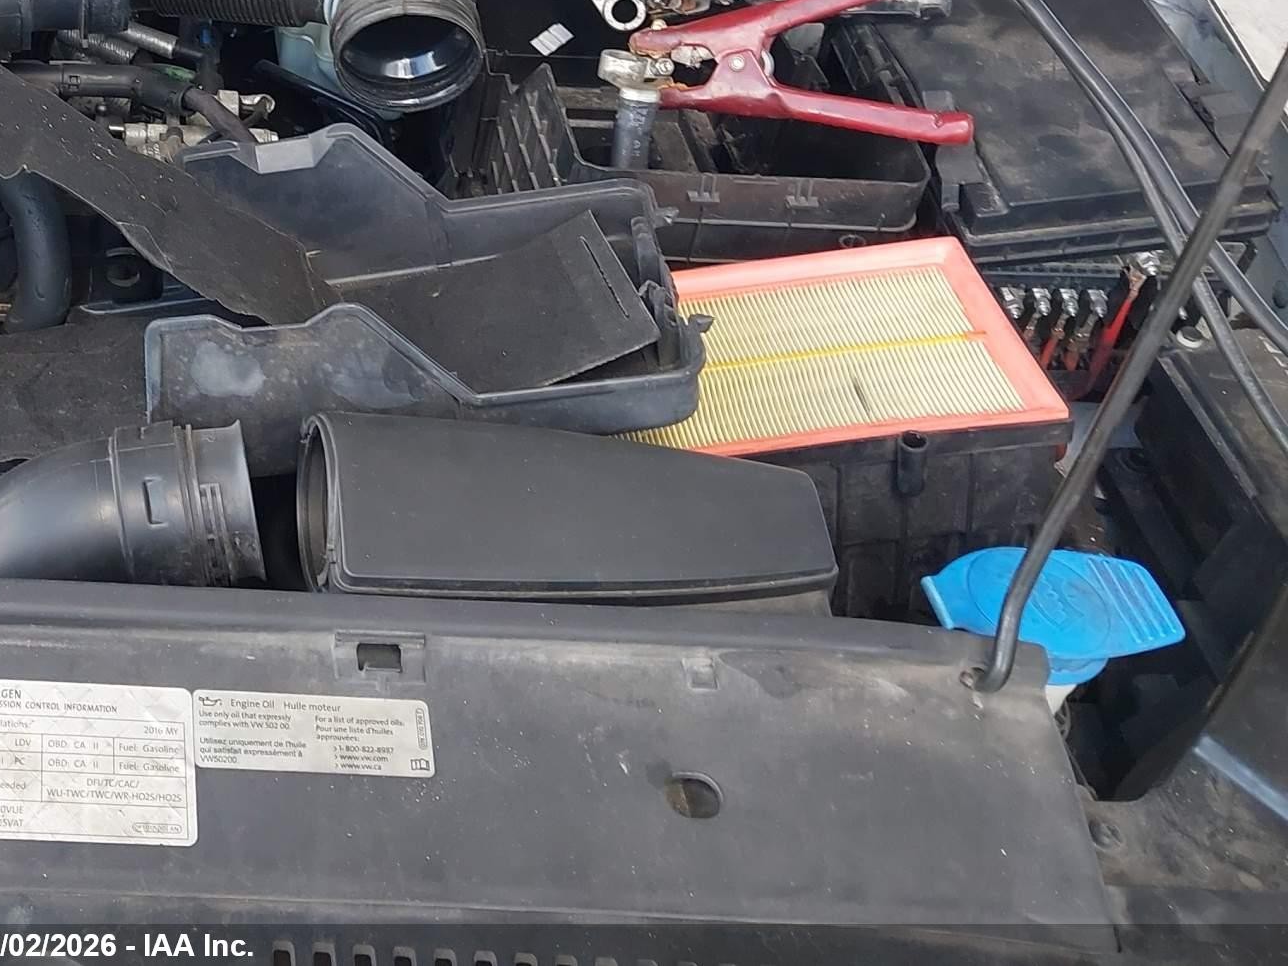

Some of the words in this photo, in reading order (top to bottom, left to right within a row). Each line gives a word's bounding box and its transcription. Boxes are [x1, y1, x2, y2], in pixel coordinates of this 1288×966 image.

[25, 701, 60, 710] CONTROL
[64, 702, 118, 713] INFORMATION
[231, 699, 261, 709] Engine
[262, 700, 275, 709] Oil
[309, 703, 341, 712] moteur
[198, 710, 212, 718] Use
[214, 712, 229, 721] only
[258, 714, 292, 723] expressly
[333, 716, 345, 724] list
[355, 719, 389, 727] approved
[198, 720, 231, 728] complies
[315, 724, 332, 732] Pour
[348, 726, 364, 734] liste
[165, 726, 179, 735] MY
[14, 738, 32, 747] LDV
[74, 741, 87, 750] CA
[142, 744, 180, 754] Gasoline
[199, 737, 227, 746] Utilisez
[228, 739, 272, 749] uniquement
[199, 746, 212, 754] qui
[213, 747, 242, 755] satisfait
[243, 748, 297, 758] expressément
[340, 754, 389, 763] www.vw.com
[74, 759, 87, 769] CA
[143, 763, 180, 773] Gasoline
[341, 762, 383, 771] www.vw.ca
